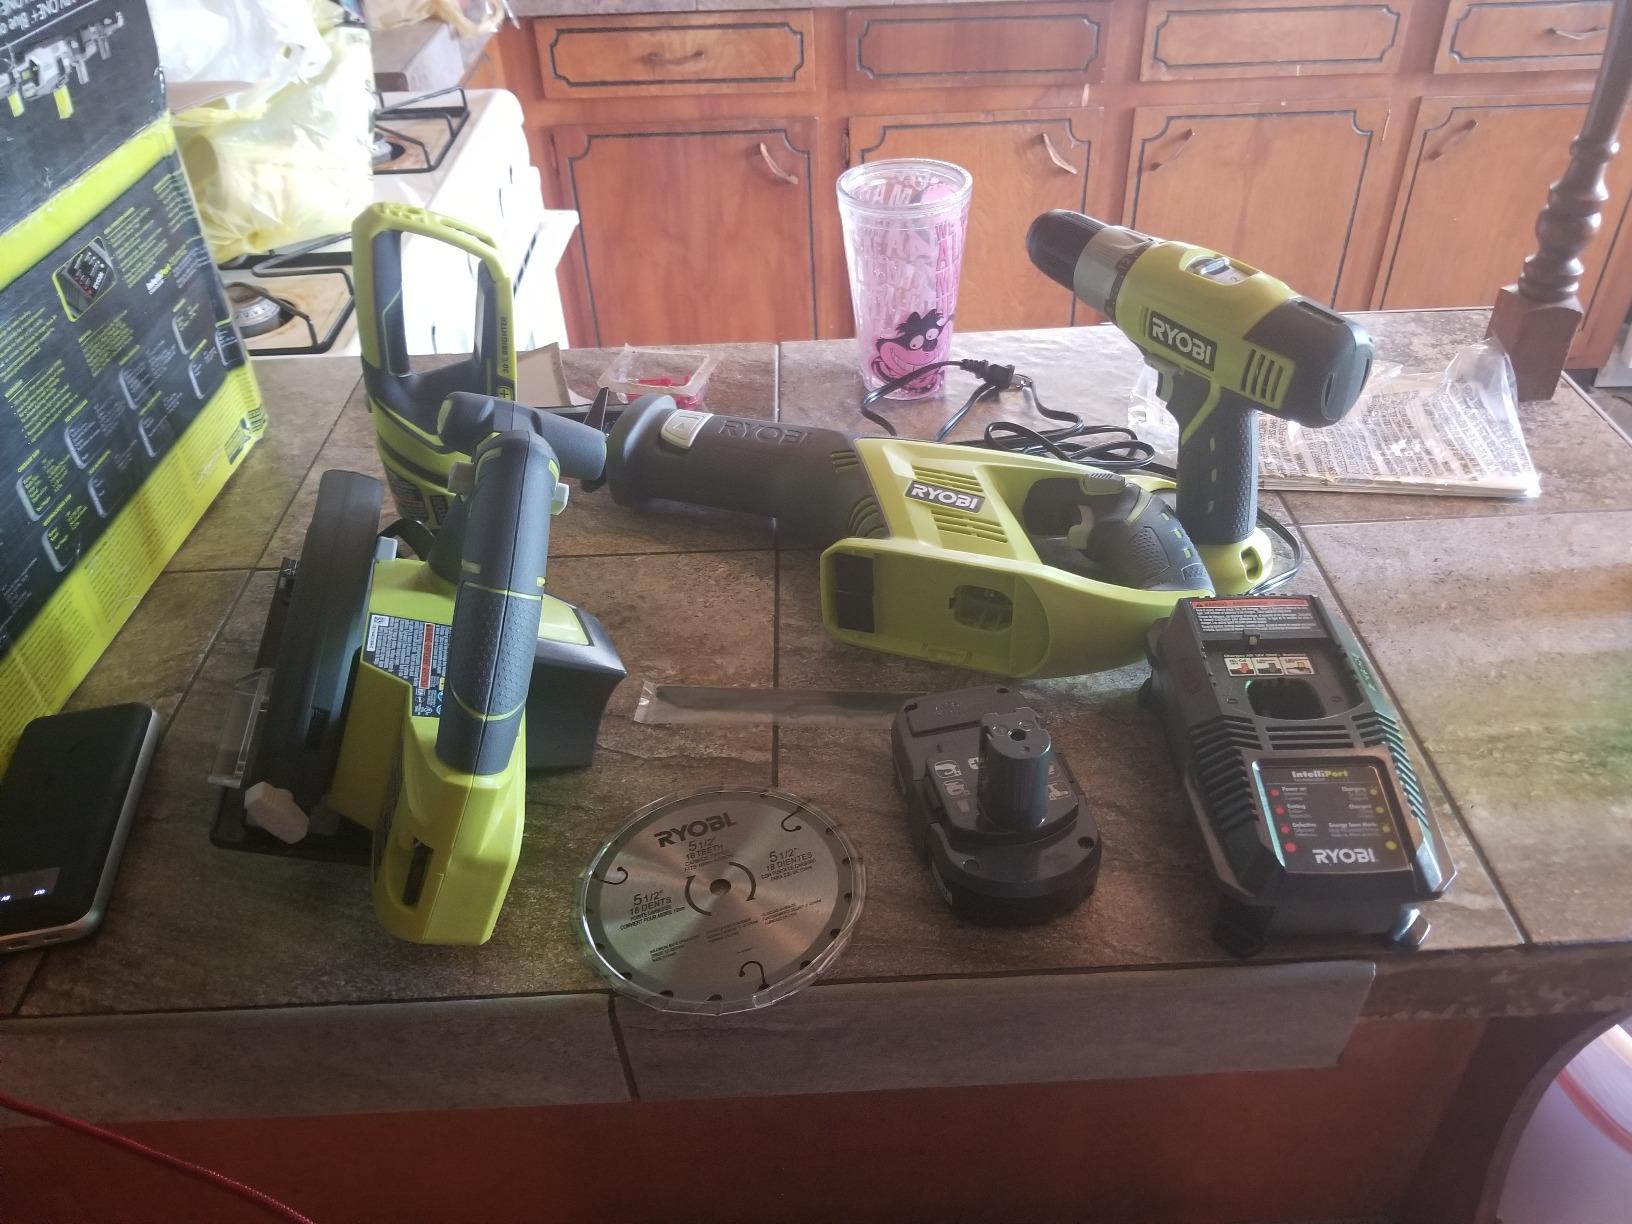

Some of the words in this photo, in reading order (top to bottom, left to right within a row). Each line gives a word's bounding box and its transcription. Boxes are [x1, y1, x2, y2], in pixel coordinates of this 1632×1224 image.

[1152, 317, 1211, 365] RYOBI
[717, 419, 812, 446] RYOBI
[911, 483, 979, 510] RYOBI
[1291, 769, 1348, 779] IntelliPort
[654, 812, 736, 848] RYOBI
[777, 851, 813, 868] DIENTES
[1312, 848, 1376, 864] RYOBI
[642, 896, 672, 912] DENTS
